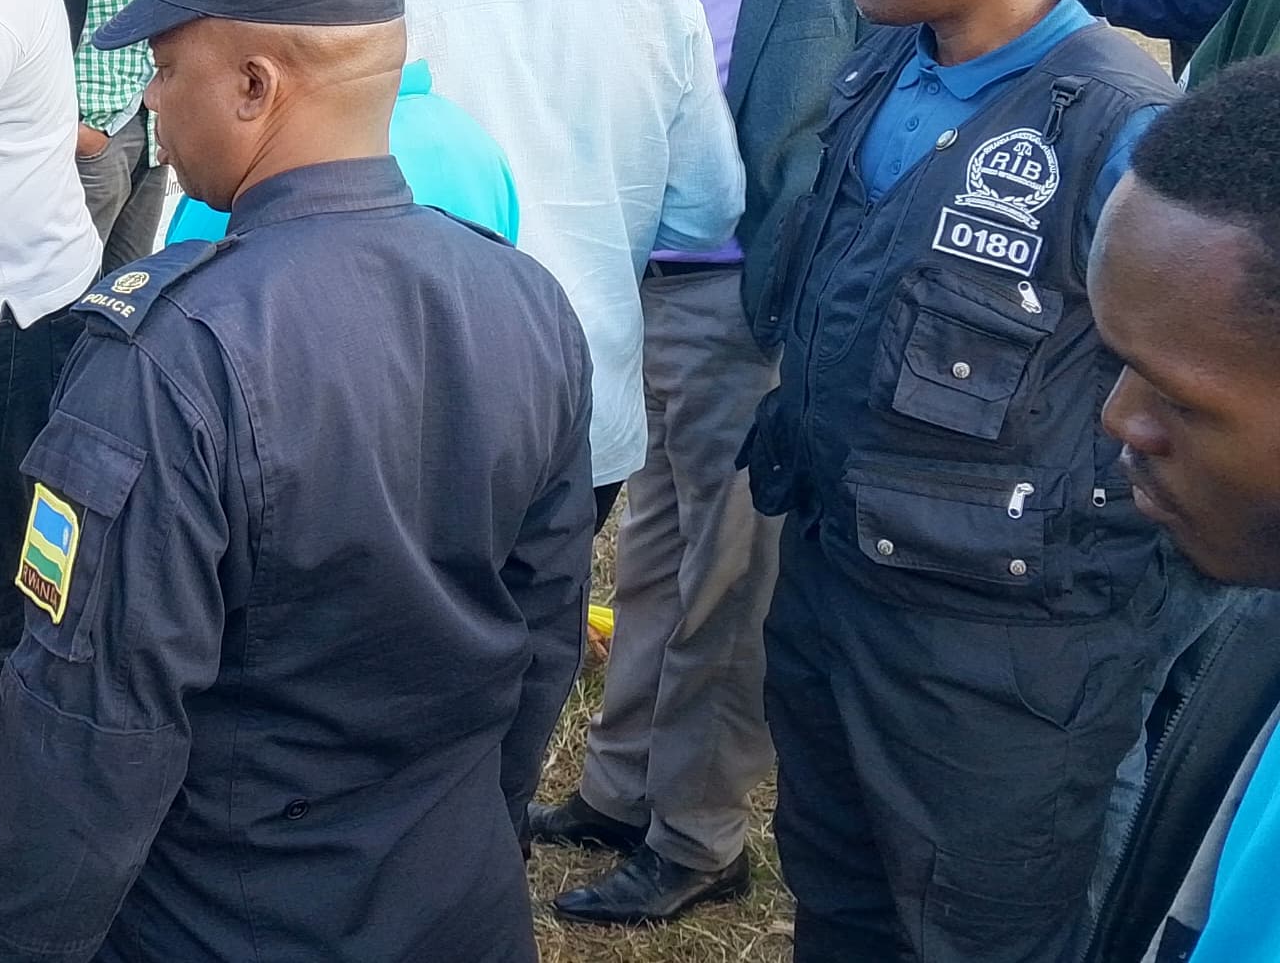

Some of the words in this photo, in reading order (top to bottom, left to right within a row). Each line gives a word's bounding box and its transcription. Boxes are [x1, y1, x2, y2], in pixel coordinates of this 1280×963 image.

[989, 151, 1042, 181] RIB
[951, 223, 1030, 264] 0180
[81, 293, 136, 318] POLICE
